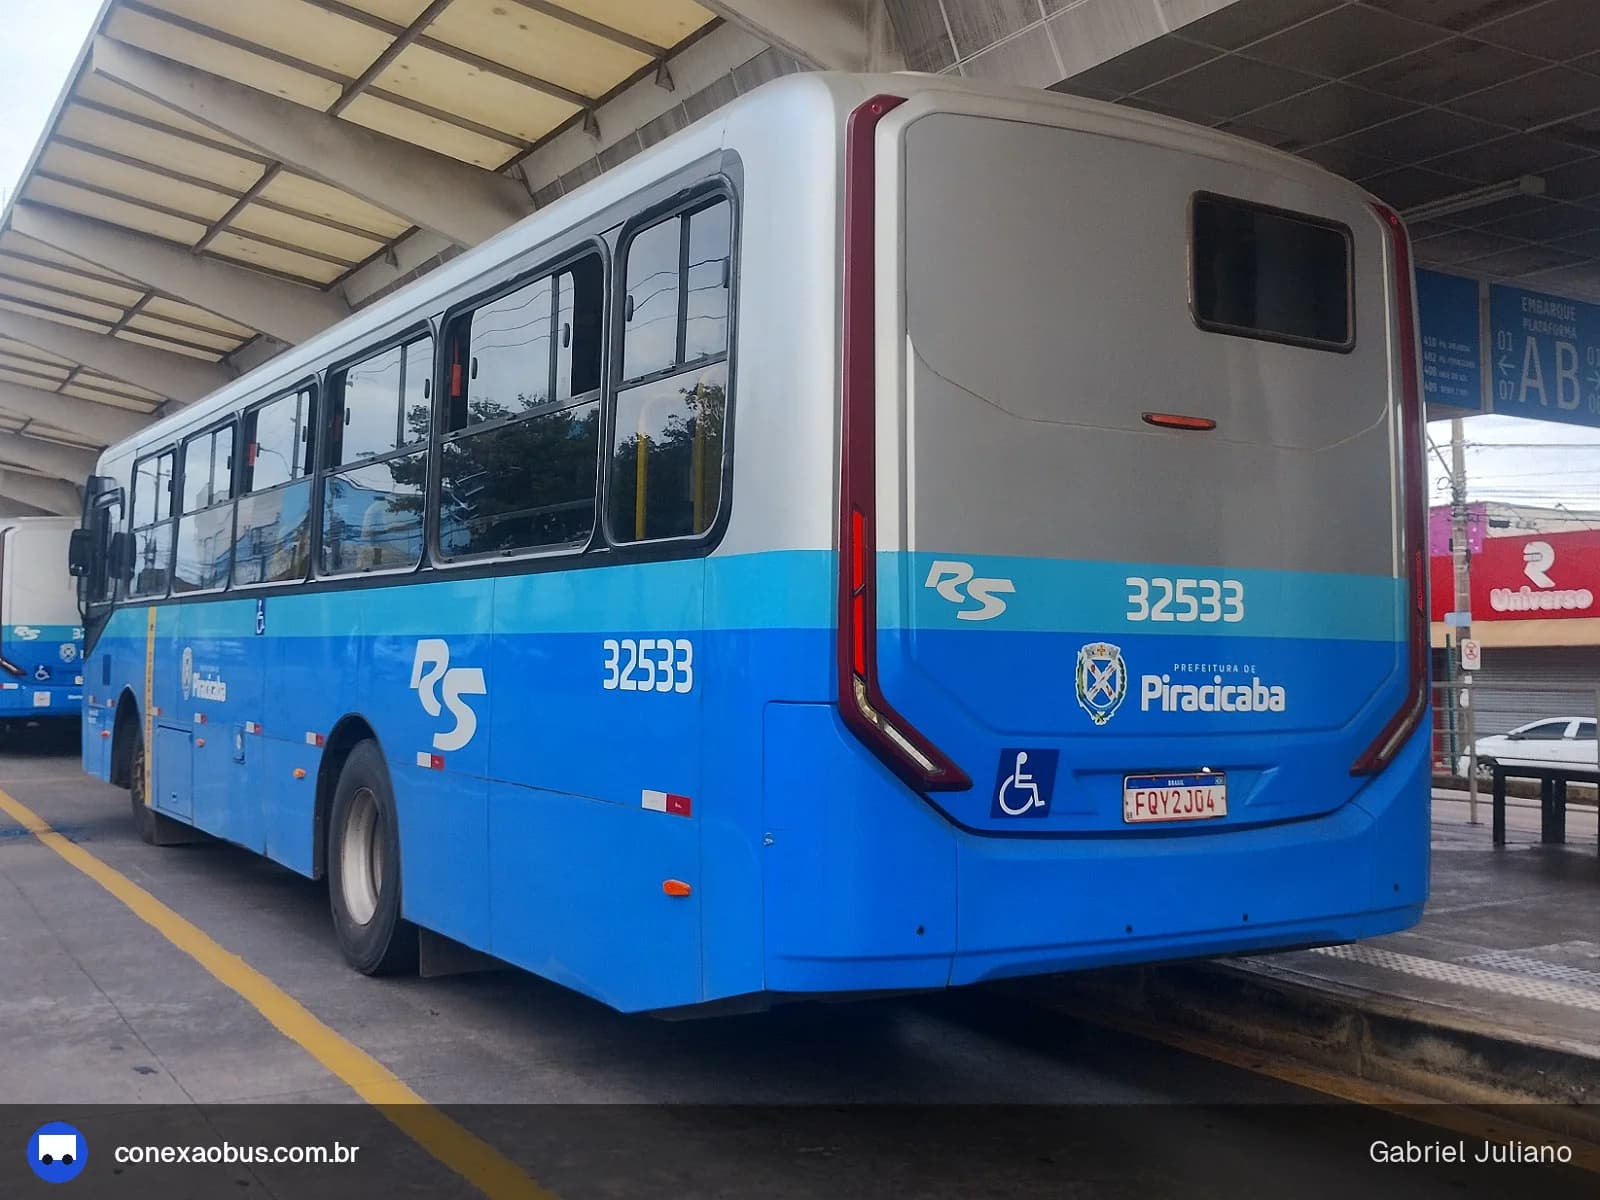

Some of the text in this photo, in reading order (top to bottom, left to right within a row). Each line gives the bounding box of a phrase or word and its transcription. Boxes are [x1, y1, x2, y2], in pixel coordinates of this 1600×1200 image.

[1521, 296, 1577, 321] EMBARQUE
[1497, 329, 1513, 352] 01
[1522, 317, 1577, 340] PLATAFORMA
[1518, 335, 1581, 411] A B
[1498, 379, 1515, 401] 07
[924, 559, 1017, 622] RS
[1125, 576, 1246, 623] 32533
[1490, 585, 1594, 612] Universo
[603, 638, 694, 694] 32533
[1173, 663, 1257, 674] PREFEITURA DE
[409, 638, 487, 752] RS
[1140, 674, 1286, 712] Piracicaba
[1167, 779, 1185, 787] BRASIL
[1135, 788, 1215, 816] FQY2J04
